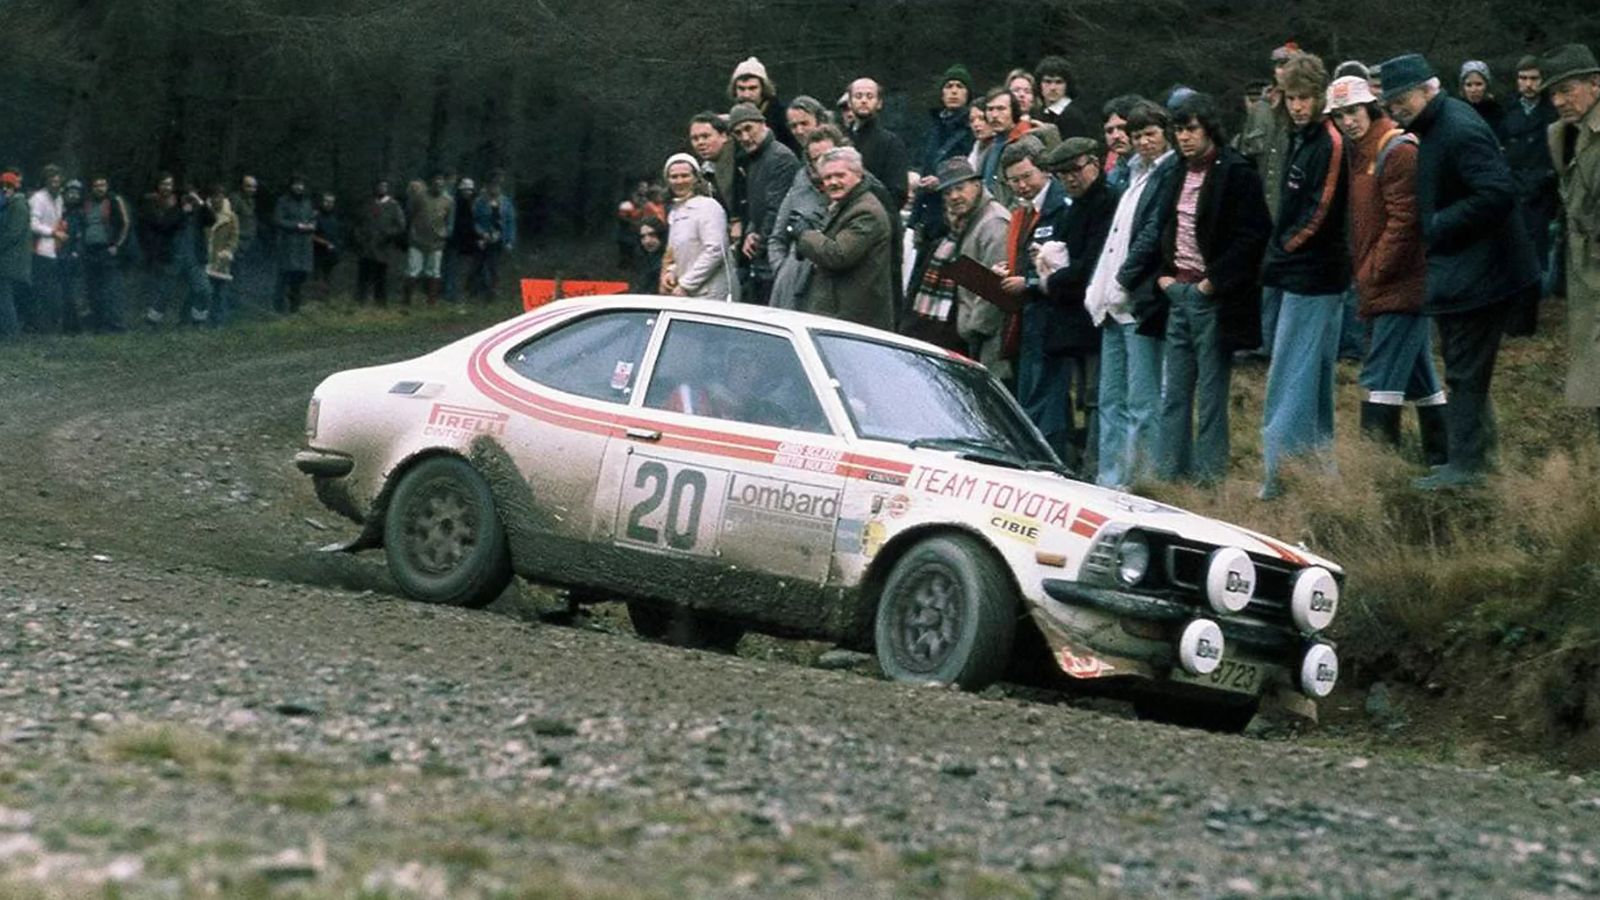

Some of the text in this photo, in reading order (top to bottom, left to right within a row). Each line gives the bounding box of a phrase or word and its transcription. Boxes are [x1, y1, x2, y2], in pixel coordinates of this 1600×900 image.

[427, 403, 509, 436] PIRELLI
[627, 460, 707, 550] 20
[727, 473, 840, 518] Lombard
[914, 465, 1071, 529] TEAM TOYOTA
[990, 516, 1039, 540] CIBIE
